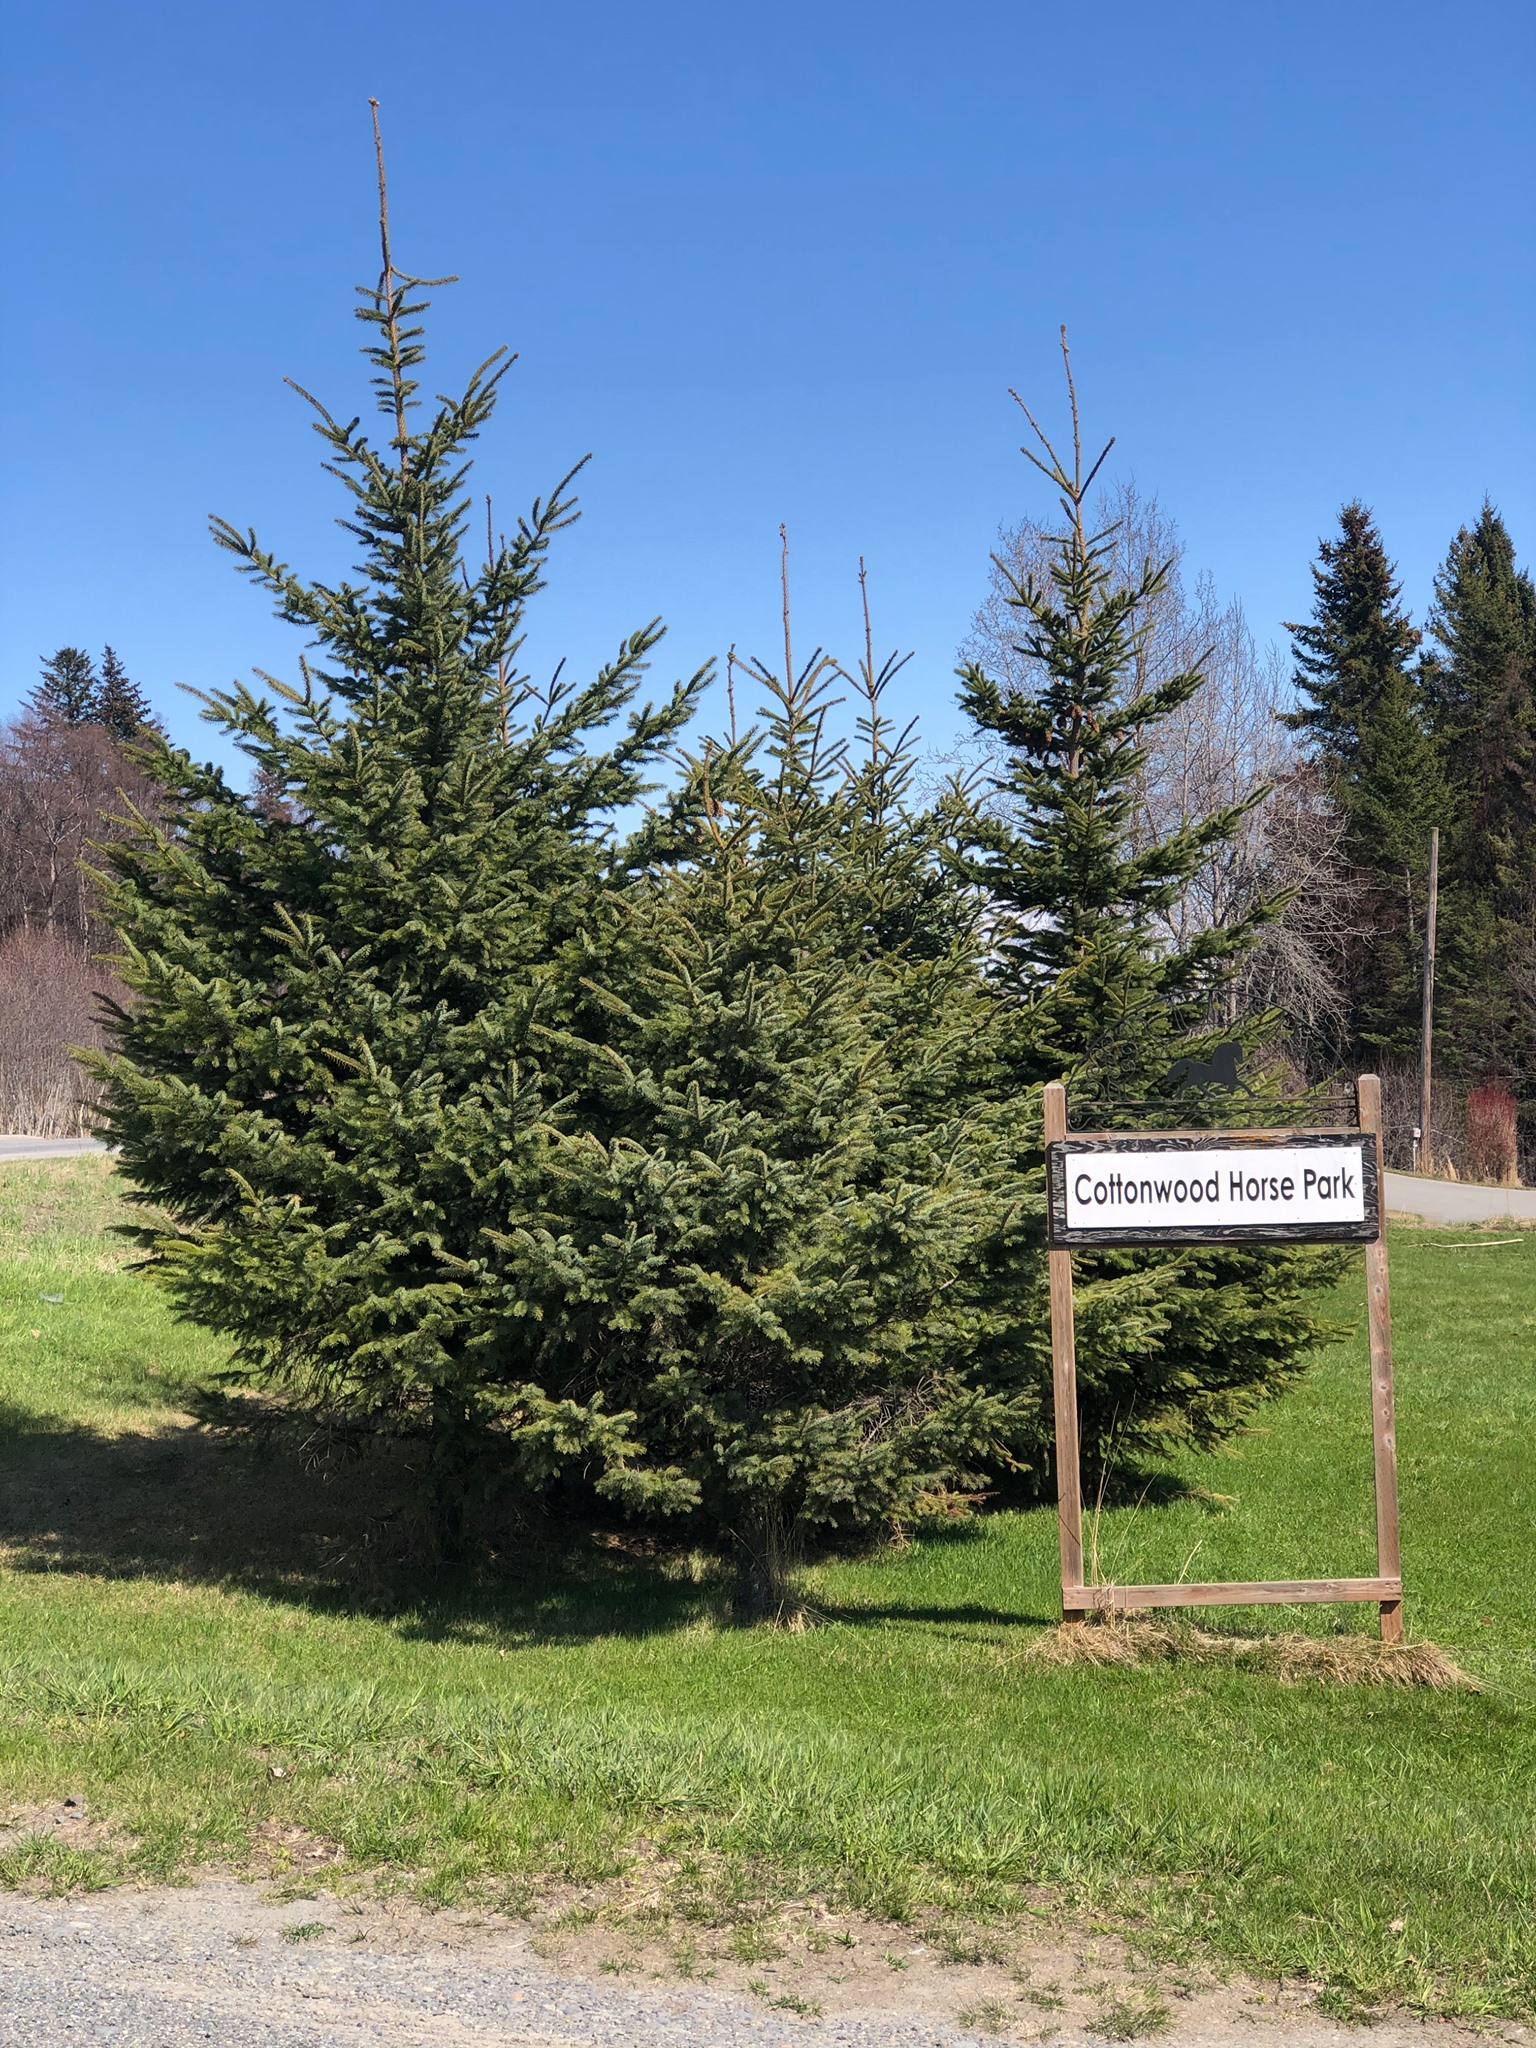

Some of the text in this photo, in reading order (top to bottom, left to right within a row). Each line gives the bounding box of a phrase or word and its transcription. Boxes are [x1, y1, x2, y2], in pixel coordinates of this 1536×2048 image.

[1074, 1167, 1355, 1206] Cottonwood Horse Park
